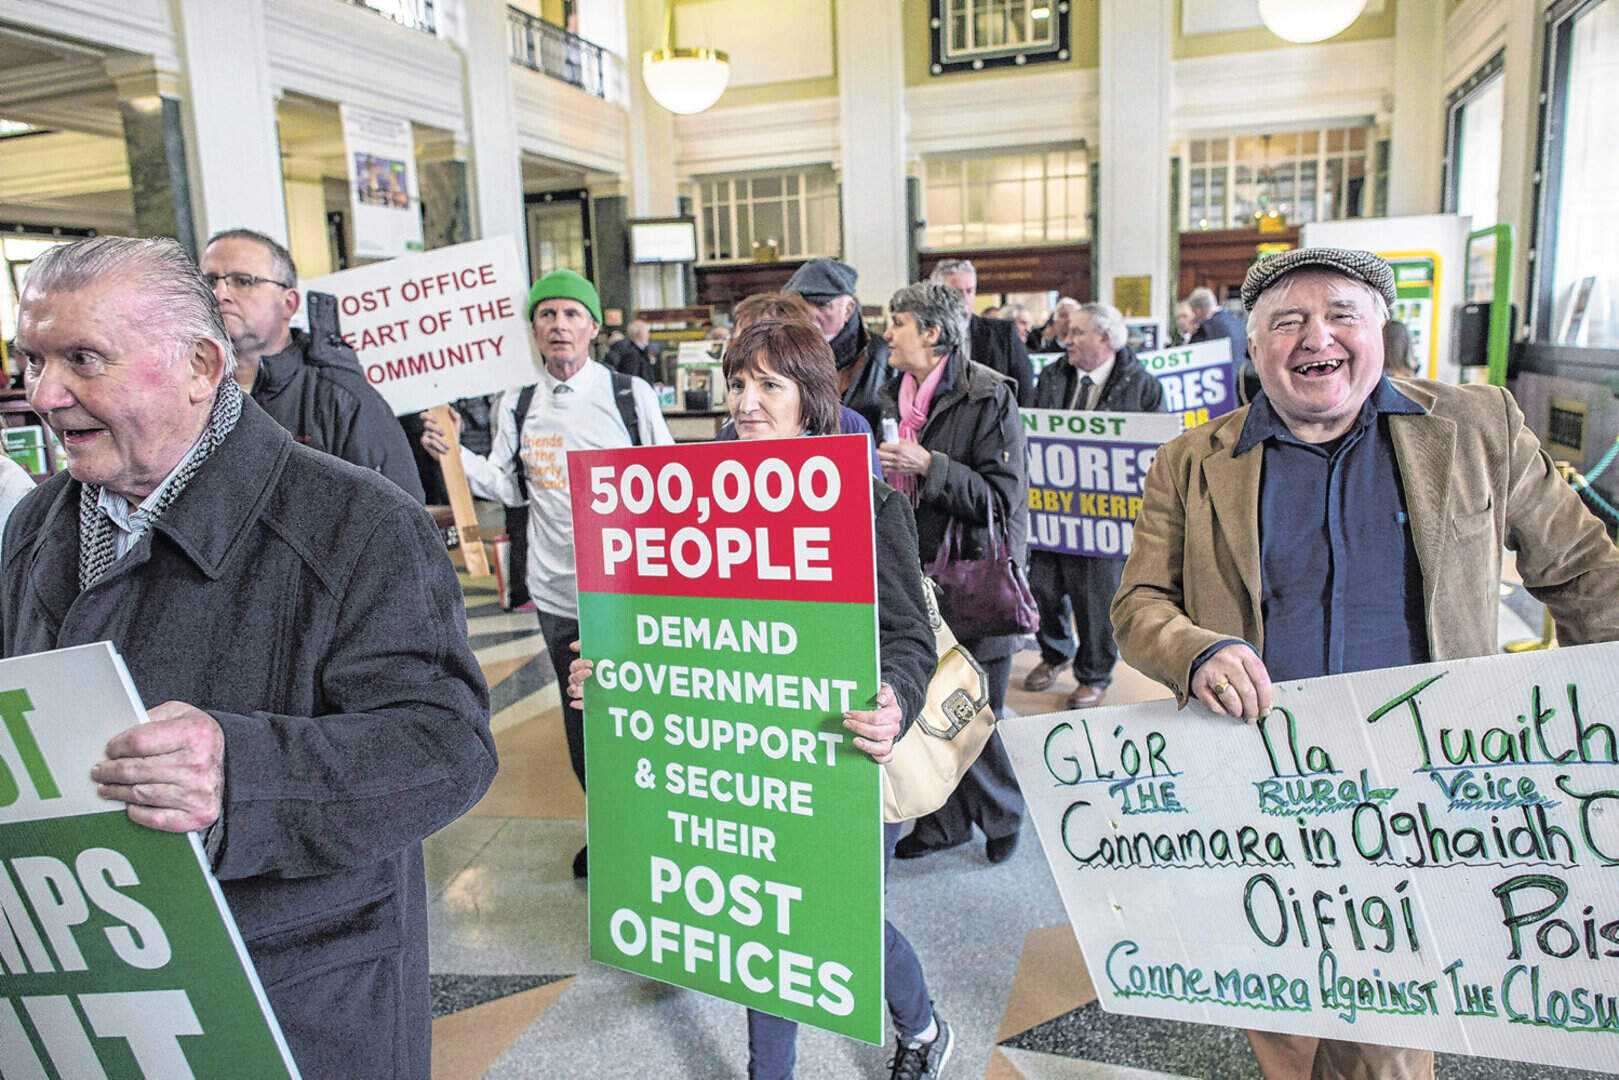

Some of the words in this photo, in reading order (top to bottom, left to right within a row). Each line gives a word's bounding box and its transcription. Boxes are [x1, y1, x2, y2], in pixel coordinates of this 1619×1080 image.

[341, 287, 391, 316] OST
[401, 264, 497, 303] OFFICE
[341, 321, 410, 352] EART
[419, 311, 453, 336] OF
[460, 297, 515, 326] THE
[367, 336, 504, 384] OMMUNITY
[1160, 367, 1227, 412] RES
[1021, 414, 1038, 432] N
[1048, 415, 1126, 436] POST
[590, 455, 841, 524] 500,000
[1029, 488, 1073, 513] BBY
[601, 526, 833, 581] PEOPLE
[636, 614, 798, 655] DEMAND
[595, 659, 858, 713] GOVERNMENT
[608, 707, 654, 741] TO
[663, 713, 843, 767] SUPPORT
[634, 758, 656, 789] &
[665, 762, 814, 816] SECURE
[1109, 779, 1181, 810] THE
[667, 810, 776, 862] THEIR
[1297, 816, 1338, 863] in
[0, 847, 172, 974] MPS
[650, 855, 803, 936] POST
[609, 907, 855, 1017] OFFICES
